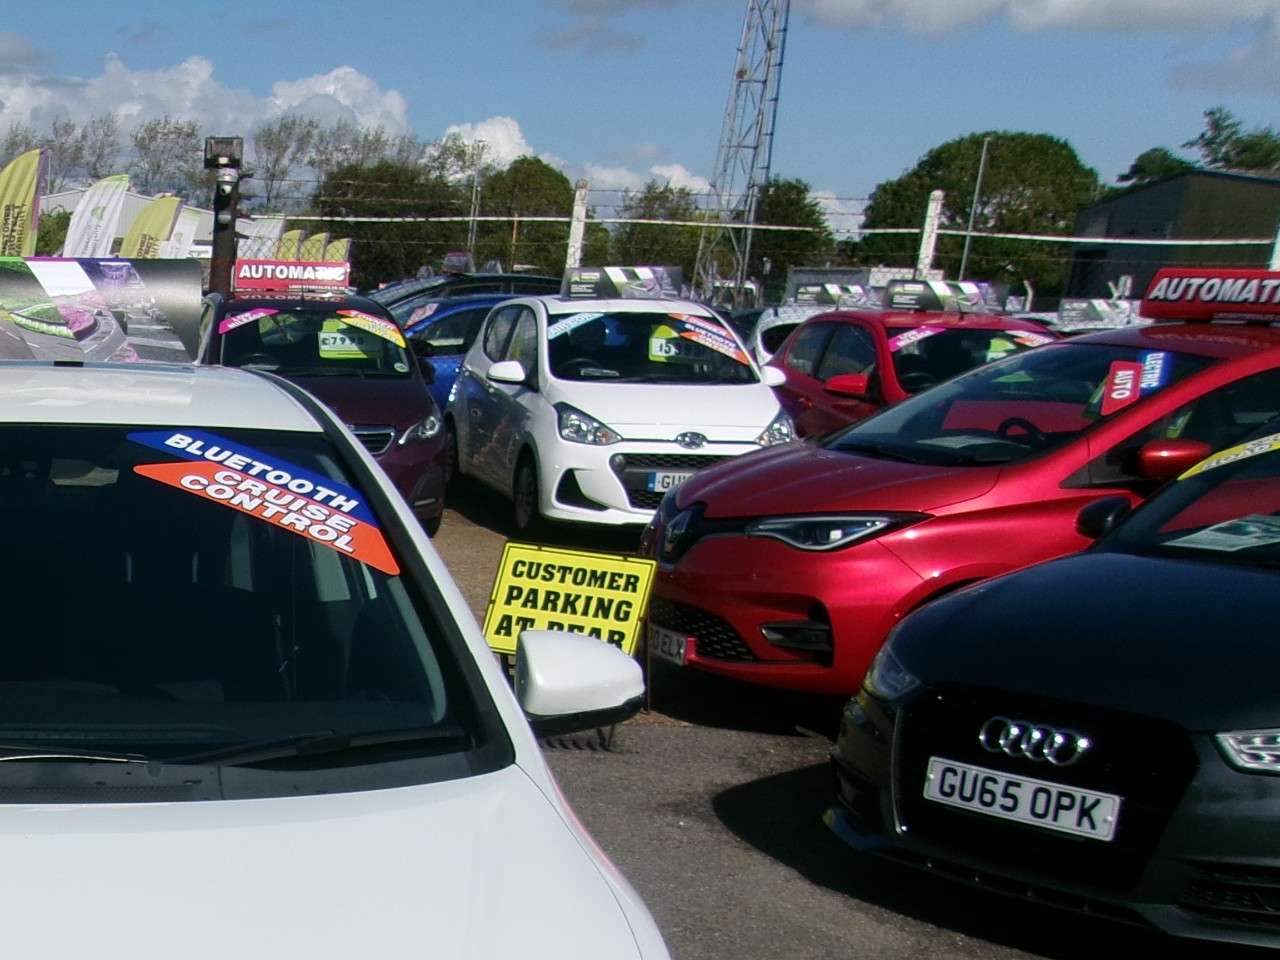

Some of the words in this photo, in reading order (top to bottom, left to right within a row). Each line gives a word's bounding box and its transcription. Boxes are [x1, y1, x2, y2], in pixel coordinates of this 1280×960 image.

[1148, 276, 1280, 304] AUTOMATI
[1111, 370, 1134, 399] AUTO
[1140, 352, 1165, 388] ELECTRIC
[164, 433, 359, 513] BLUETOOTH
[179, 474, 355, 553] CONTROL
[213, 470, 358, 533] CRUISE
[511, 559, 641, 593] CUSTOMER
[504, 585, 633, 623] PARKING
[494, 614, 535, 637] AT
[938, 767, 1022, 813] GU65
[1030, 786, 1102, 831] OPK
